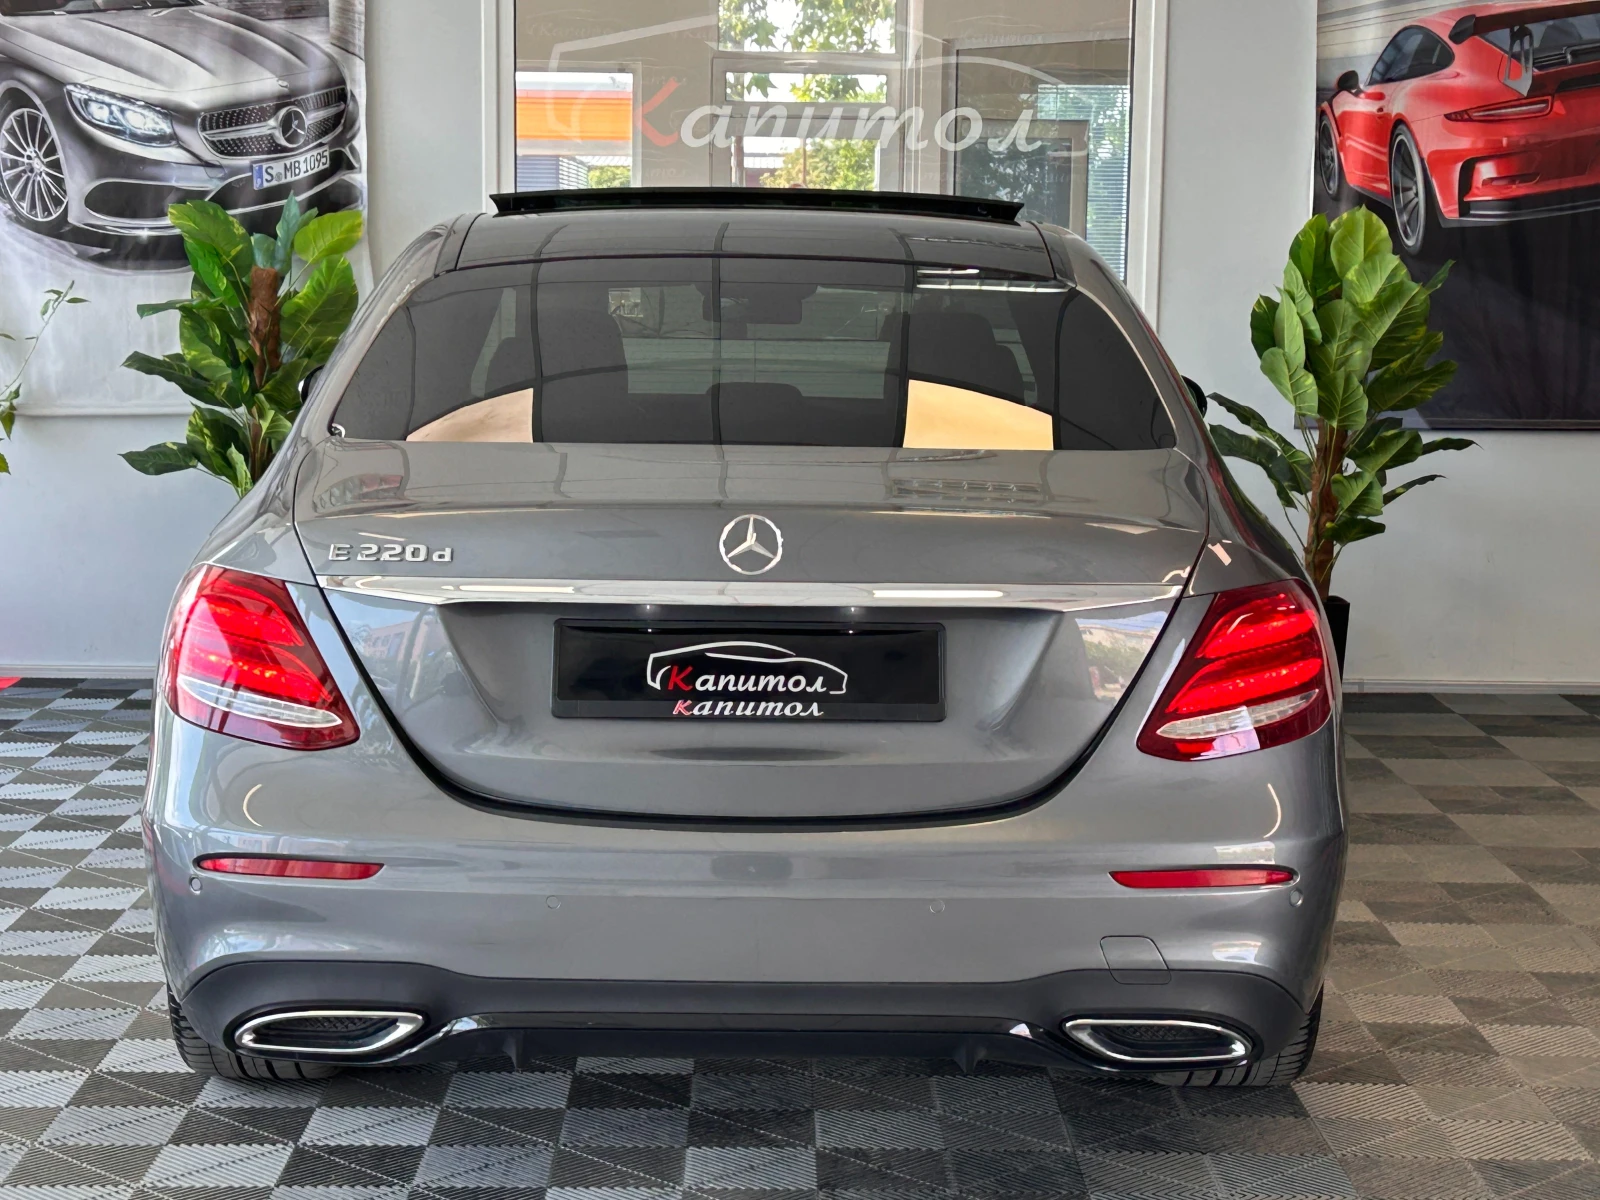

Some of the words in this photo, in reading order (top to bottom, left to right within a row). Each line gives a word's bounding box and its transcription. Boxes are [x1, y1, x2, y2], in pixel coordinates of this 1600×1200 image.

[264, 165, 275, 183] S
[283, 160, 301, 181] MB
[303, 149, 328, 174] 1095
